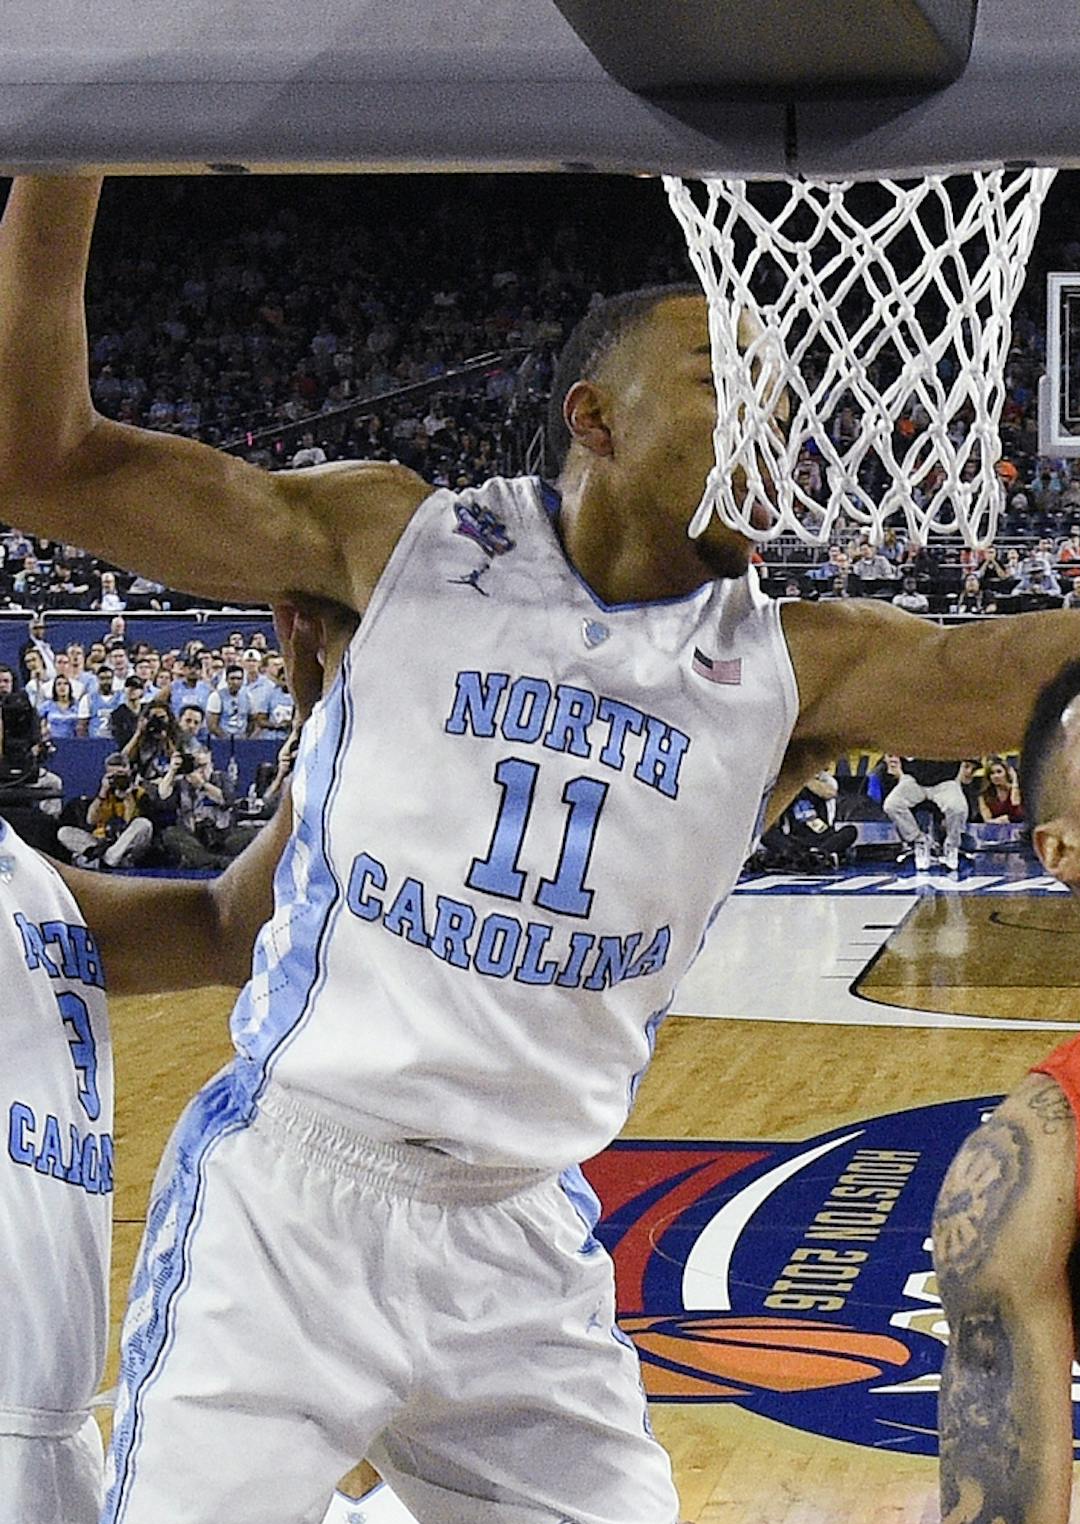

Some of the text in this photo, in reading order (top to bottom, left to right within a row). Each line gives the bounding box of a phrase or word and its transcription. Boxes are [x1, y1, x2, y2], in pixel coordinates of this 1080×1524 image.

[445, 671, 690, 800] NORTH
[465, 756, 610, 919] 11
[346, 851, 671, 992] CAROLINA
[804, 1149, 921, 1242] HOUSTON
[764, 1247, 869, 1312] 2016
